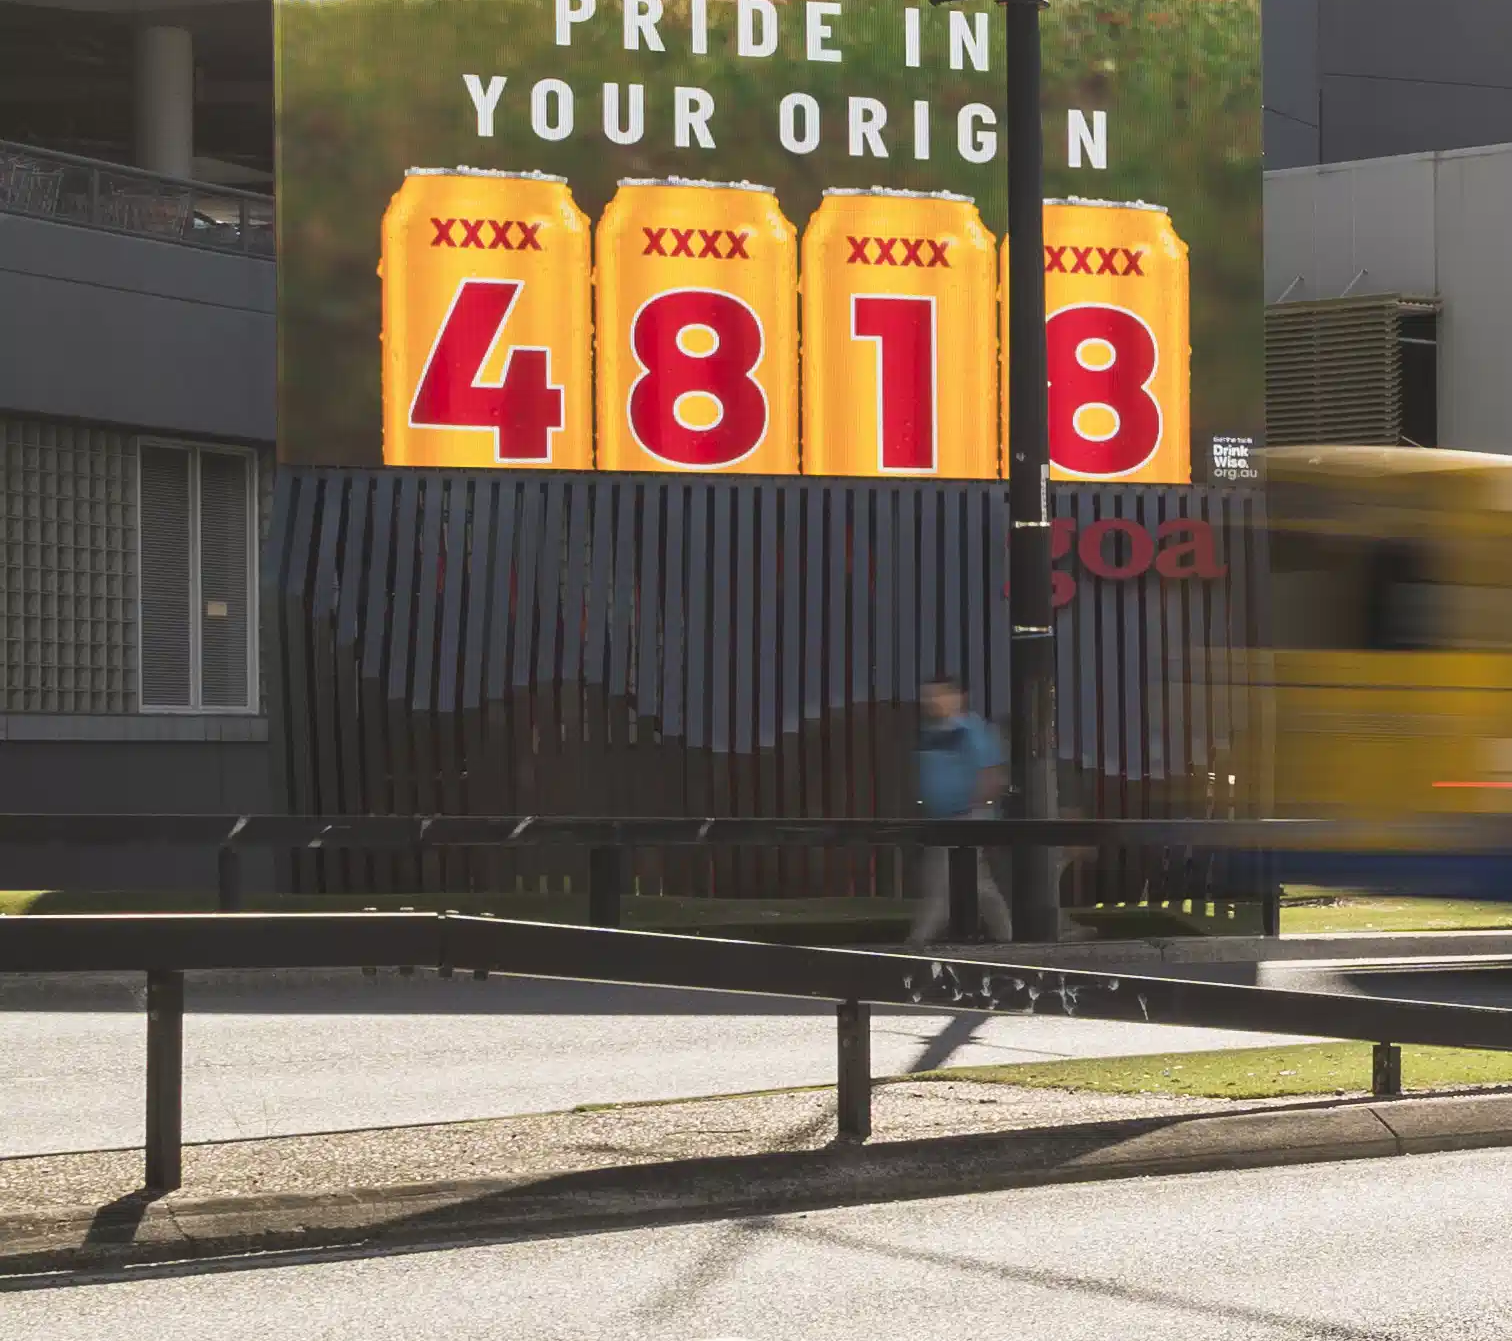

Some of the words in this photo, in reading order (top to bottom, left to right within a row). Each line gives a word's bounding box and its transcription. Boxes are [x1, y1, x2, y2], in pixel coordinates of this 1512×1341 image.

[904, 7, 990, 72] IN
[462, 73, 717, 149] YOUR
[778, 92, 1107, 170] ORIGN
[429, 217, 543, 252] XXXX
[641, 226, 750, 260] XXXX
[845, 235, 951, 269] XXXX
[1043, 245, 1145, 277] XXXX
[1213, 444, 1249, 457] Drink
[1214, 456, 1249, 469] Wise.
[1214, 468, 1258, 481] org.au
